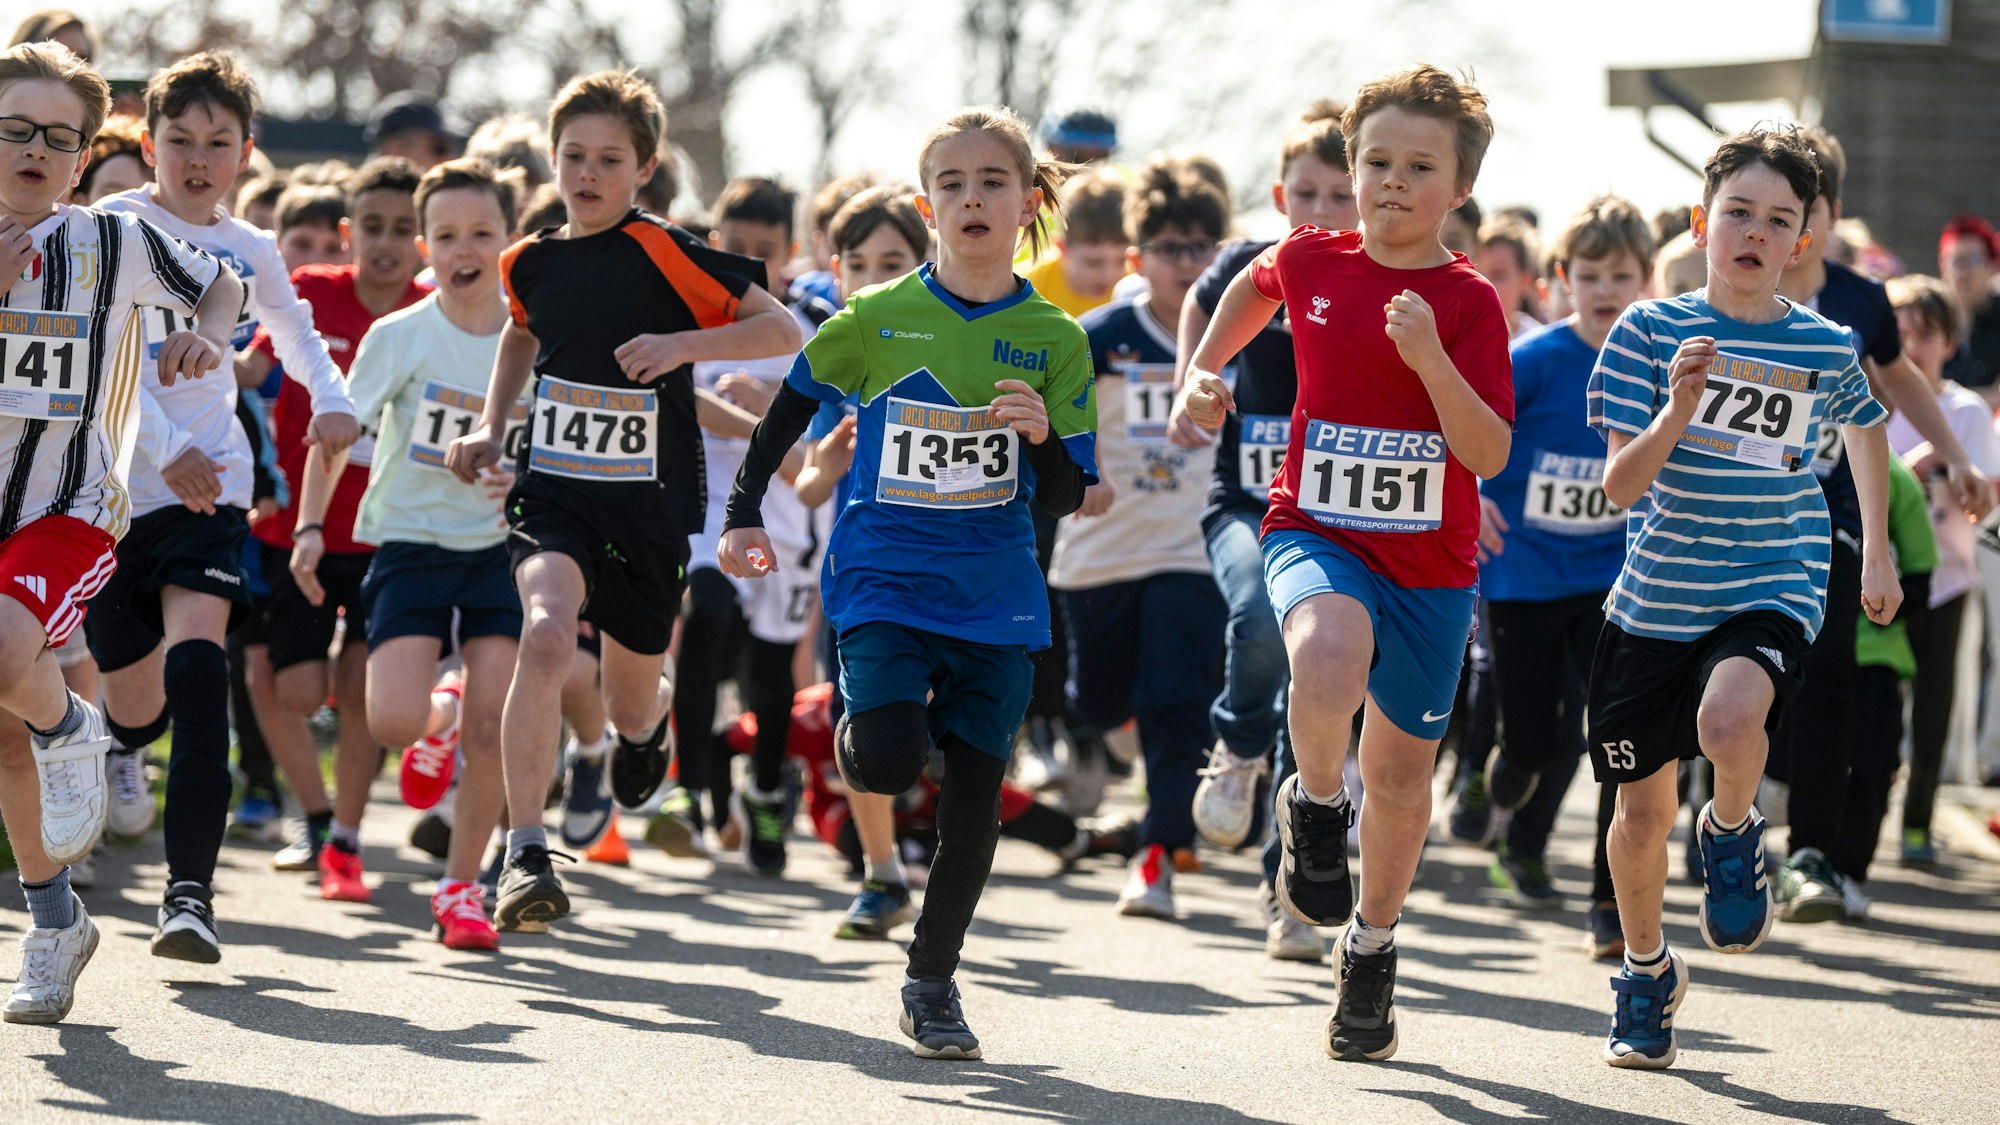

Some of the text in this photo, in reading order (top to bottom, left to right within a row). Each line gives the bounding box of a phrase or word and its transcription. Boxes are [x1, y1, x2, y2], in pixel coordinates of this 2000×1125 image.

[1306, 311, 1327, 325] hummel
[992, 338, 1048, 372] Neal
[1710, 355, 1727, 376] GO
[1730, 360, 1766, 383] BEACH
[547, 383, 568, 402] LAGO
[571, 388, 601, 408] BEACH
[1702, 379, 1792, 439] 729
[542, 405, 647, 454] 1478
[899, 405, 925, 427] LAGO
[928, 410, 961, 431] BEACH
[1251, 420, 1291, 443] PET
[893, 430, 1009, 480] 1353
[1315, 424, 1445, 459] PETERS
[1540, 452, 1606, 479] PETE
[885, 487, 1011, 502] www.lago-zuelpich.de
[1314, 459, 1428, 512] 1151
[1314, 514, 1429, 531] WWW.PETERSSPORTTEAM.DE
[204, 567, 241, 587] uhlsport
[1756, 646, 1787, 673] adidas
[1602, 739, 1636, 770] ES
